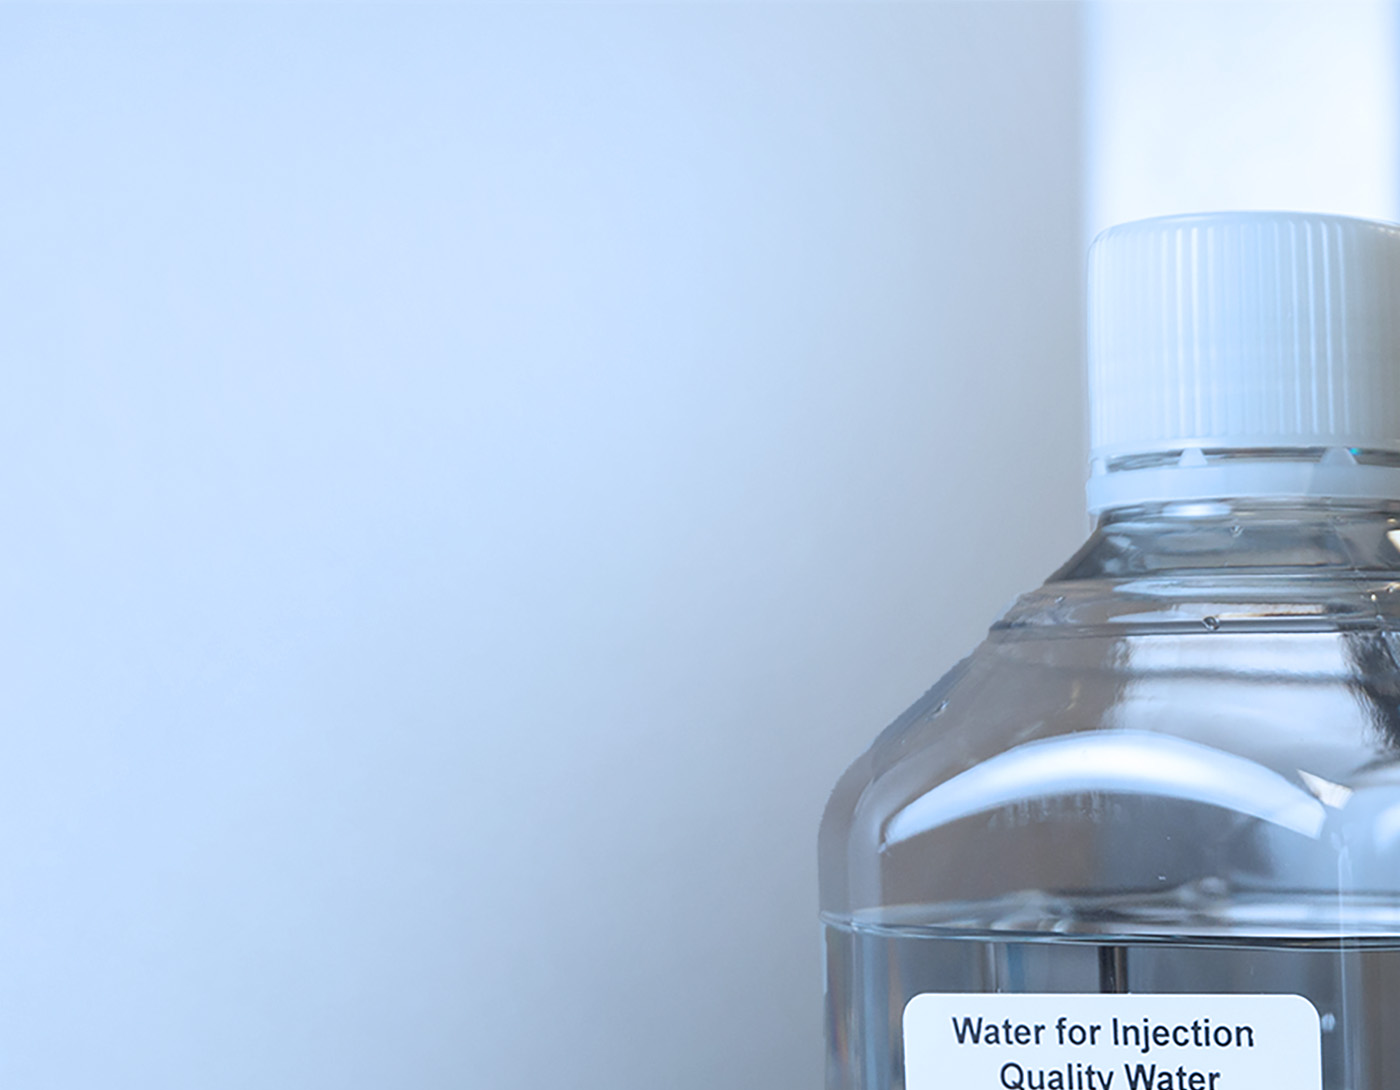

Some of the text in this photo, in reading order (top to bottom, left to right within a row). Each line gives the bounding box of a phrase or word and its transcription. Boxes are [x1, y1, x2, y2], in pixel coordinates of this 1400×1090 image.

[951, 1016, 1255, 1054] Water for Injection
